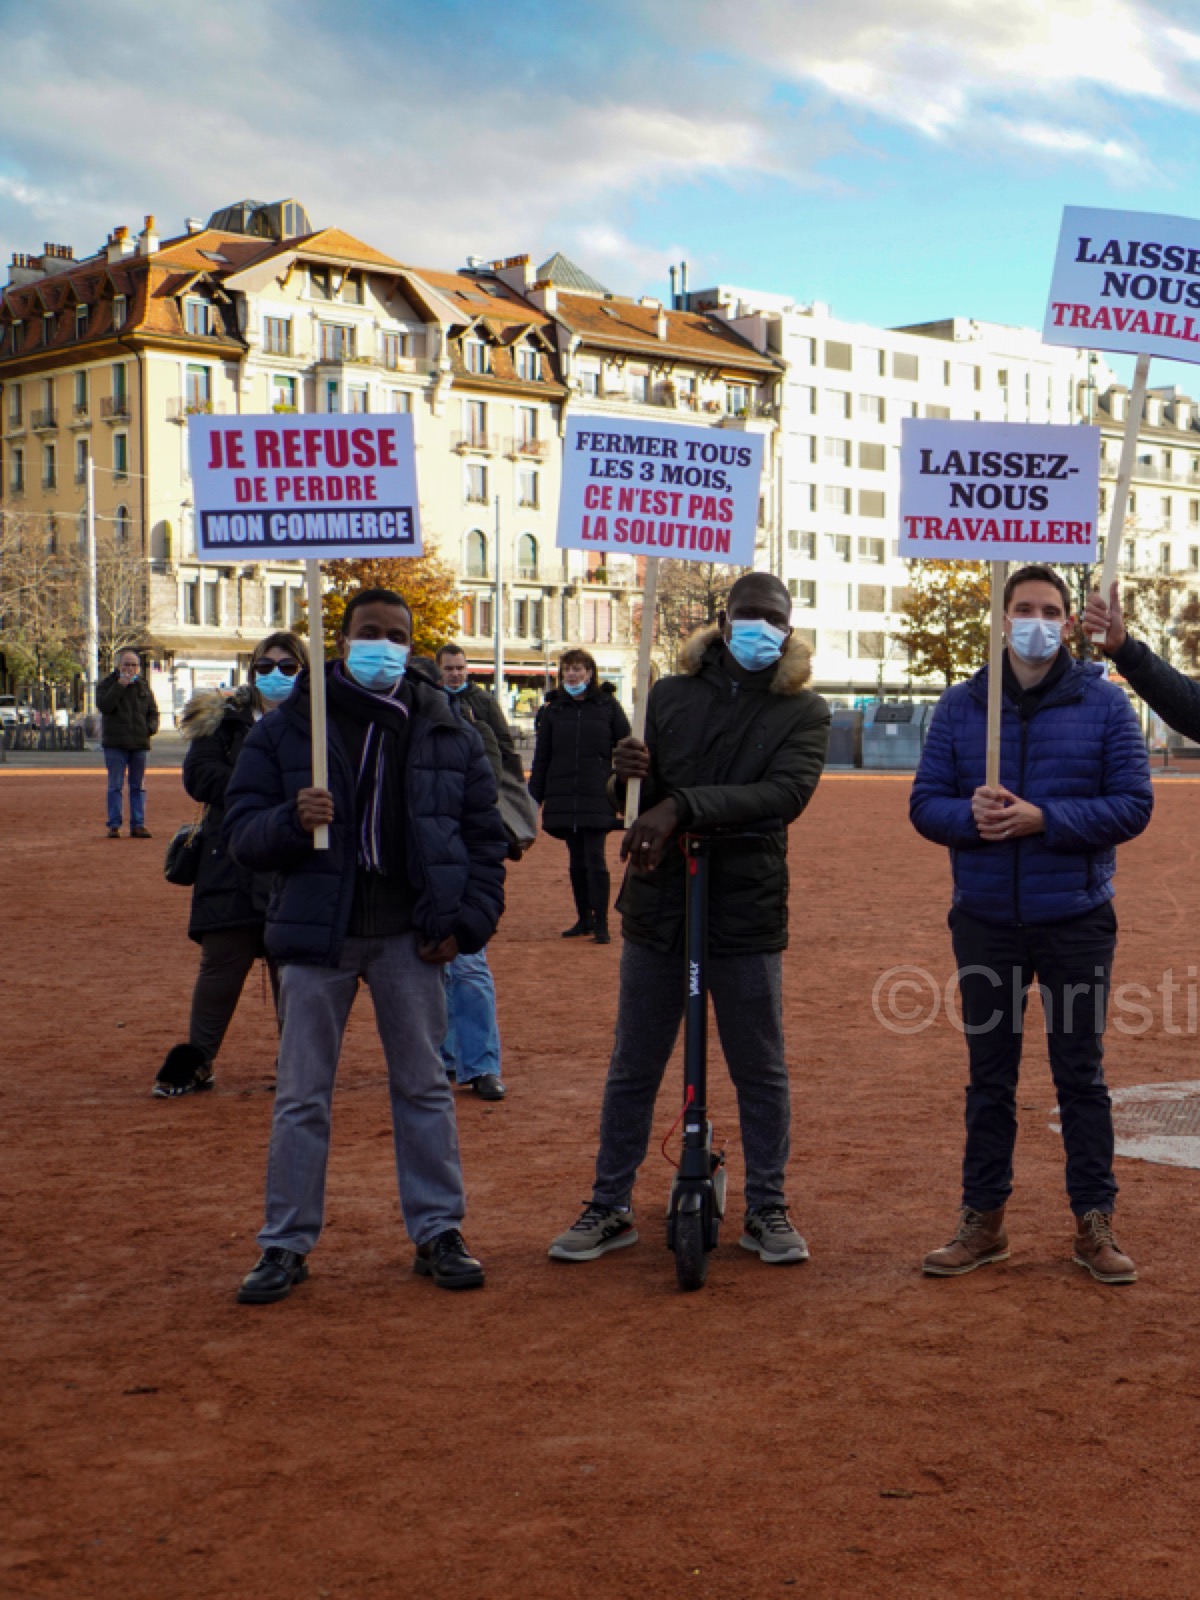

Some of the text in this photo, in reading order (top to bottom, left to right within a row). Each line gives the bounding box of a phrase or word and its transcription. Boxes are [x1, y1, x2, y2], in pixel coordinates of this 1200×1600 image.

[208, 428, 398, 469] JE REFUSE
[576, 431, 752, 467] FERMER TOUS
[919, 448, 1080, 480] LAISSEZ-
[234, 475, 378, 502] DE PERDRE
[589, 458, 733, 493] LES 3 MOIS,
[584, 484, 735, 523] CE N'EST PAS
[949, 482, 1049, 511] NOUS
[206, 510, 410, 543] MON COMMERCE
[581, 515, 731, 554] LA SOLUTION
[904, 515, 1092, 545] TRAVAILLER!
